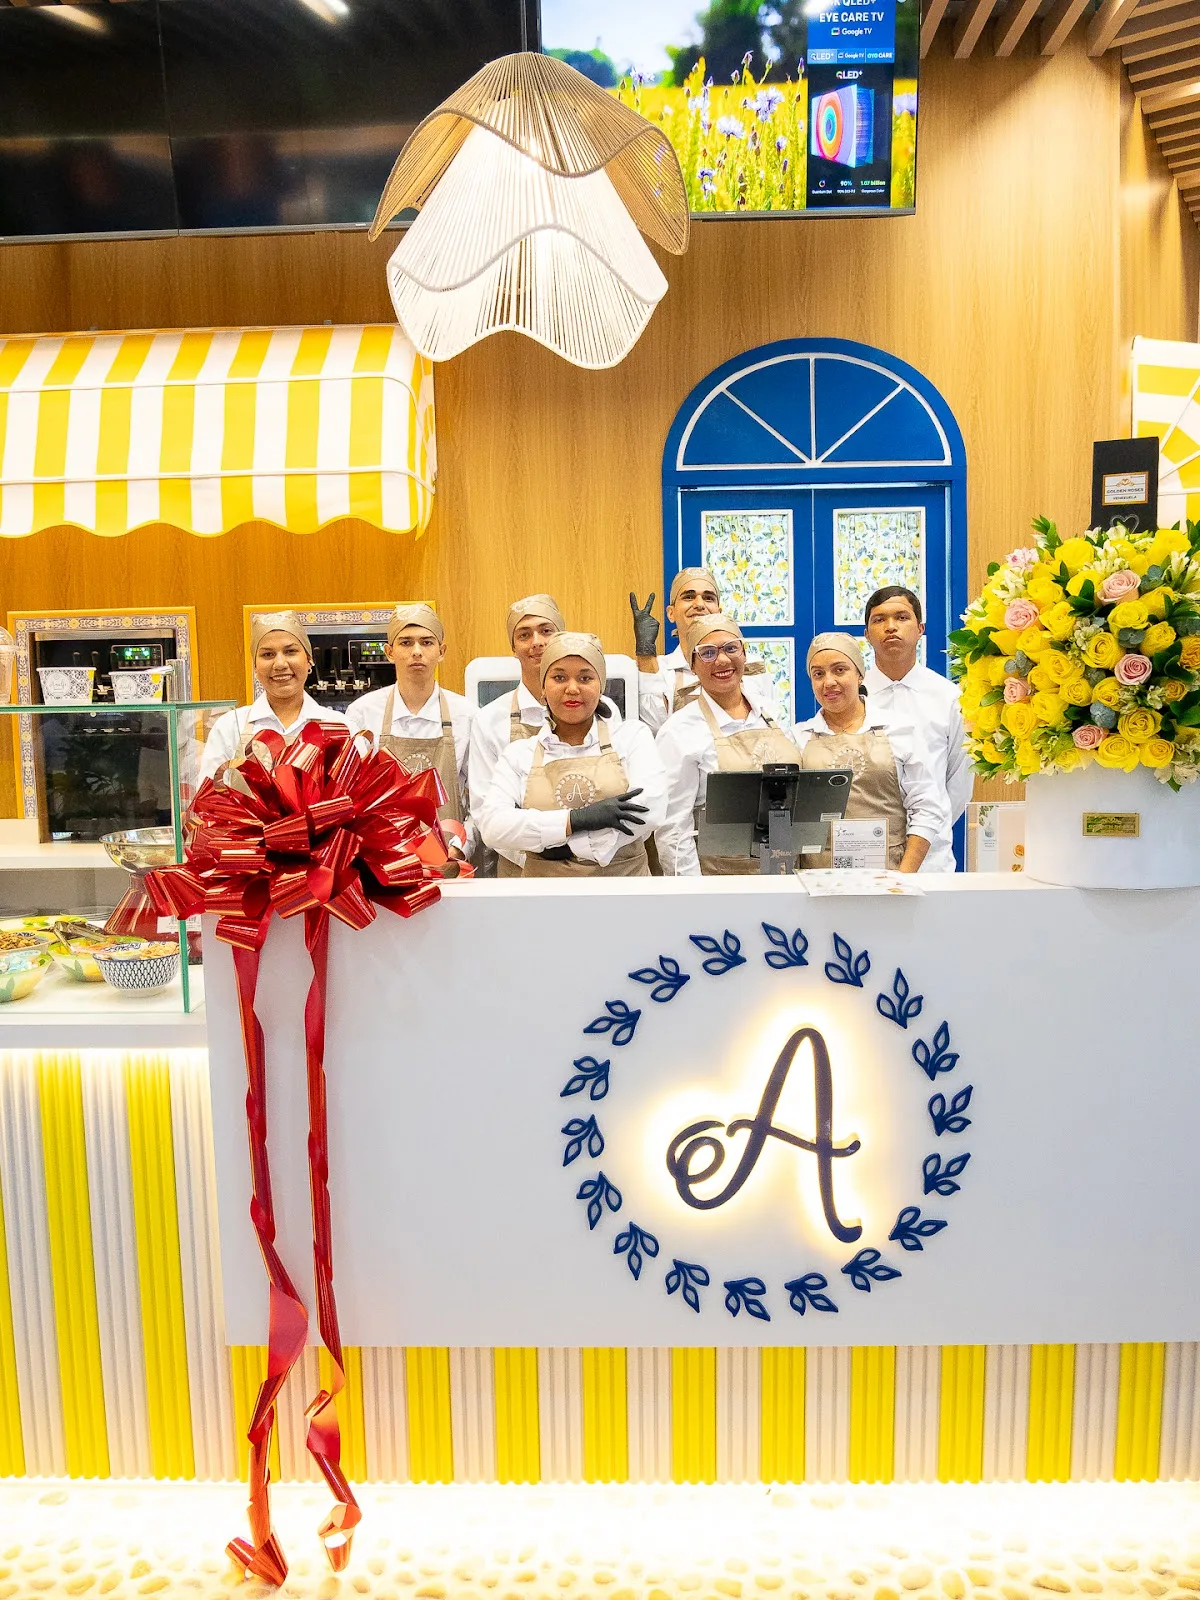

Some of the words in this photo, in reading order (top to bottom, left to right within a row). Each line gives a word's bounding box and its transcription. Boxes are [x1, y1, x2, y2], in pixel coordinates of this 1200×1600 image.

[819, 12, 839, 22] EYE
[841, 12, 869, 22] CARE
[870, 11, 884, 22] TV
[842, 28, 863, 36] Google
[566, 782, 586, 802] A
[666, 1027, 863, 1243] A
